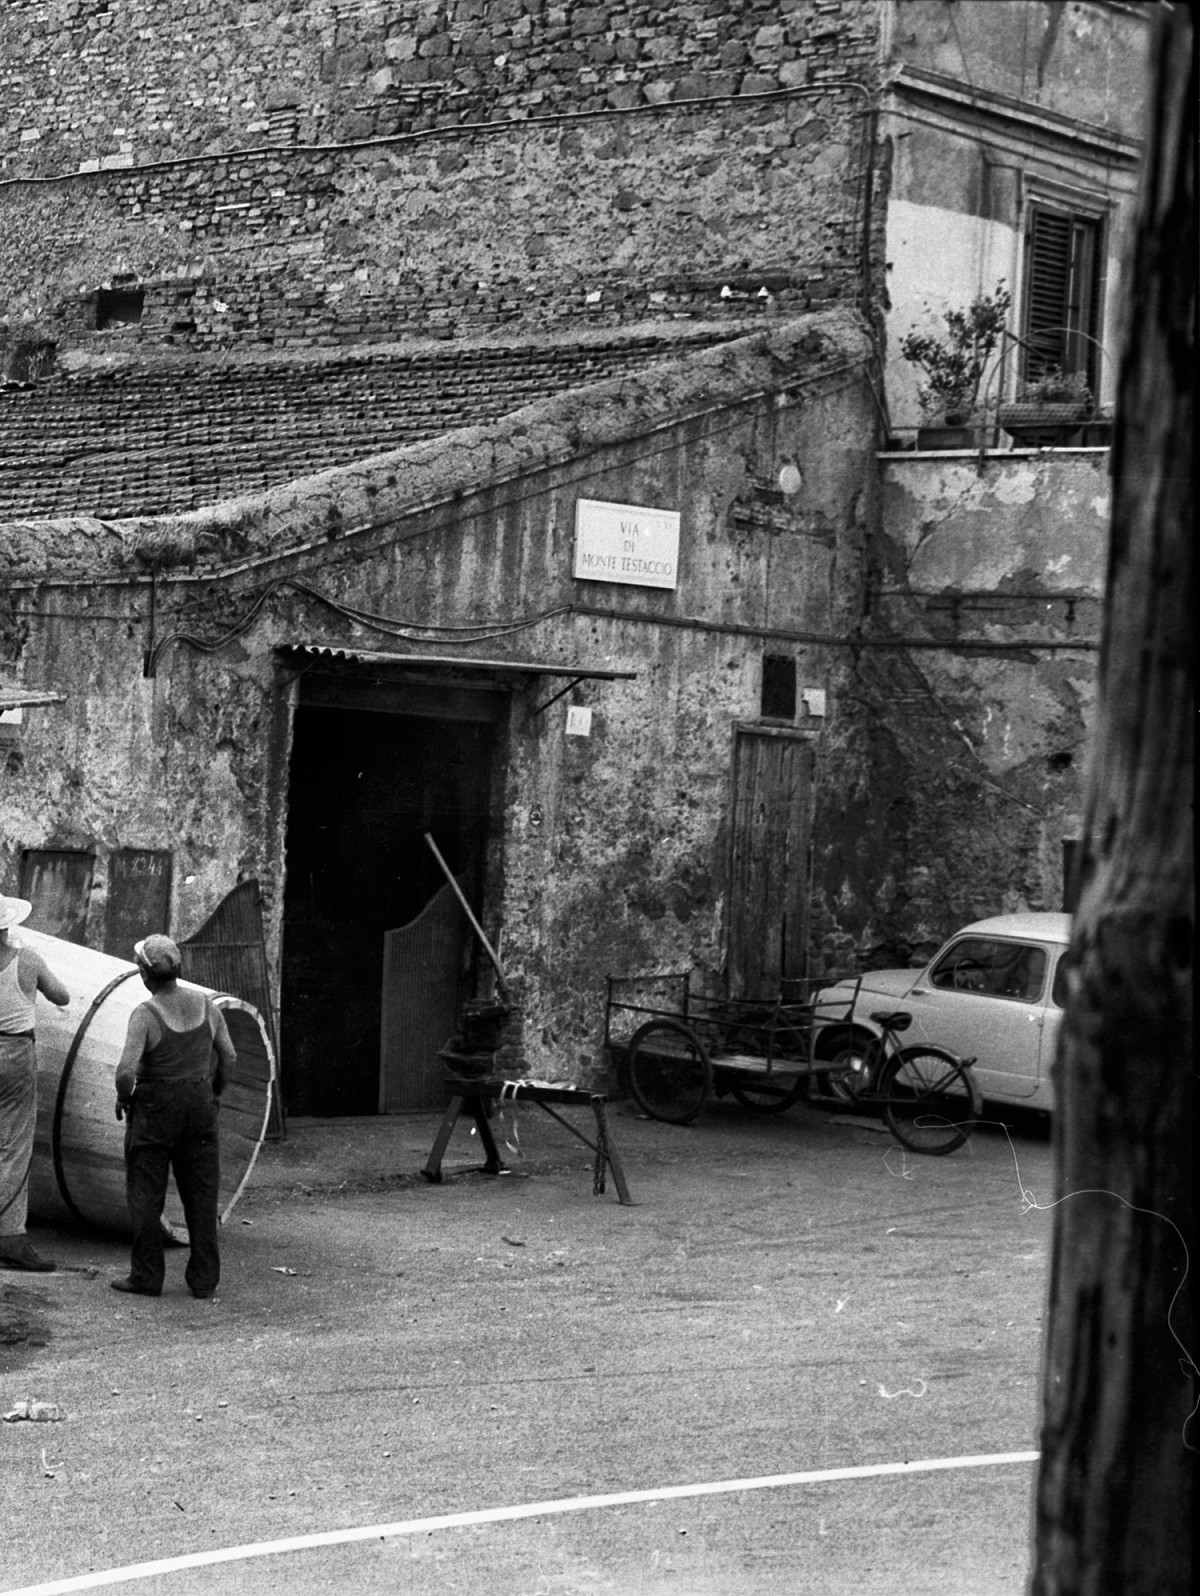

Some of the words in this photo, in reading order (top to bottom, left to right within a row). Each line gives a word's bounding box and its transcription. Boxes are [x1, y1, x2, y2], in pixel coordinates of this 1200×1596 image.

[620, 521, 639, 536] VIA
[623, 540, 635, 553] DI
[582, 553, 616, 570] MONTE
